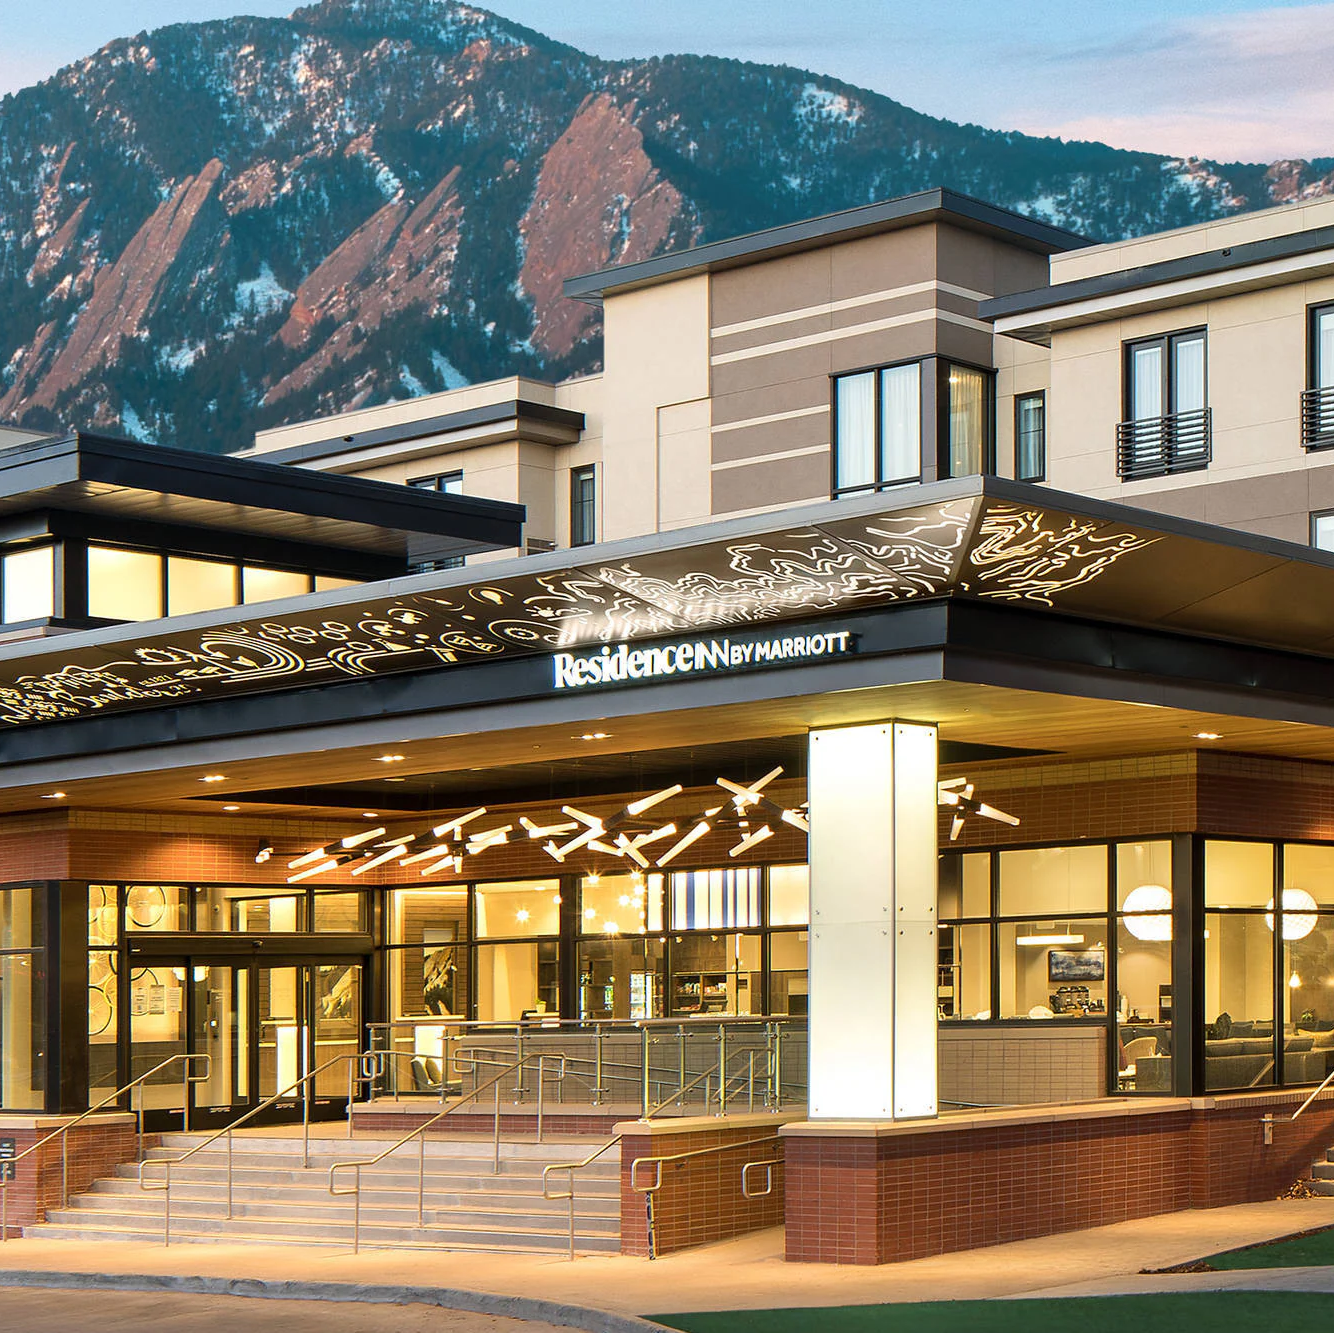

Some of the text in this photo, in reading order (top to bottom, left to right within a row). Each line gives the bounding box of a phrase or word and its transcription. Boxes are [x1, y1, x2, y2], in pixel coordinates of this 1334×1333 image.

[553, 631, 850, 688] Residence INN BY MARRIOTT
